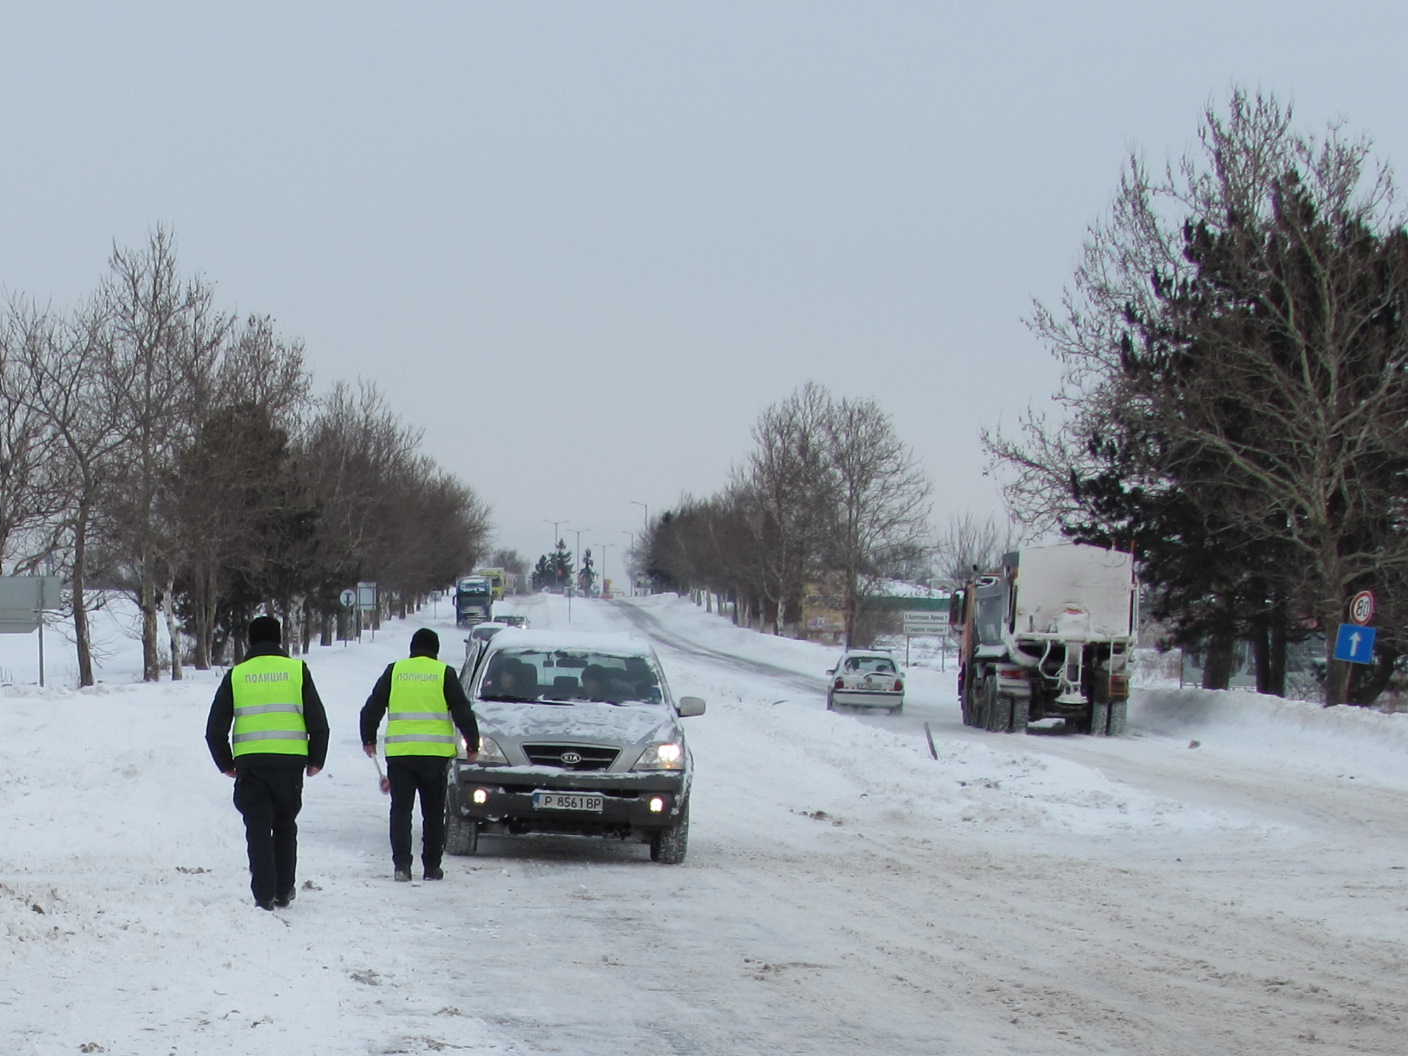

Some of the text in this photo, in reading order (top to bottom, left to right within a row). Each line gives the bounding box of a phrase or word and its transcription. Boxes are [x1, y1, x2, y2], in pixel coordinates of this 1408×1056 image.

[1356, 600, 1370, 617] 80
[245, 672, 289, 684] ПОЛИЦИЯ
[397, 672, 438, 682] ПОЛИЦИЯ
[563, 753, 578, 761] KIA
